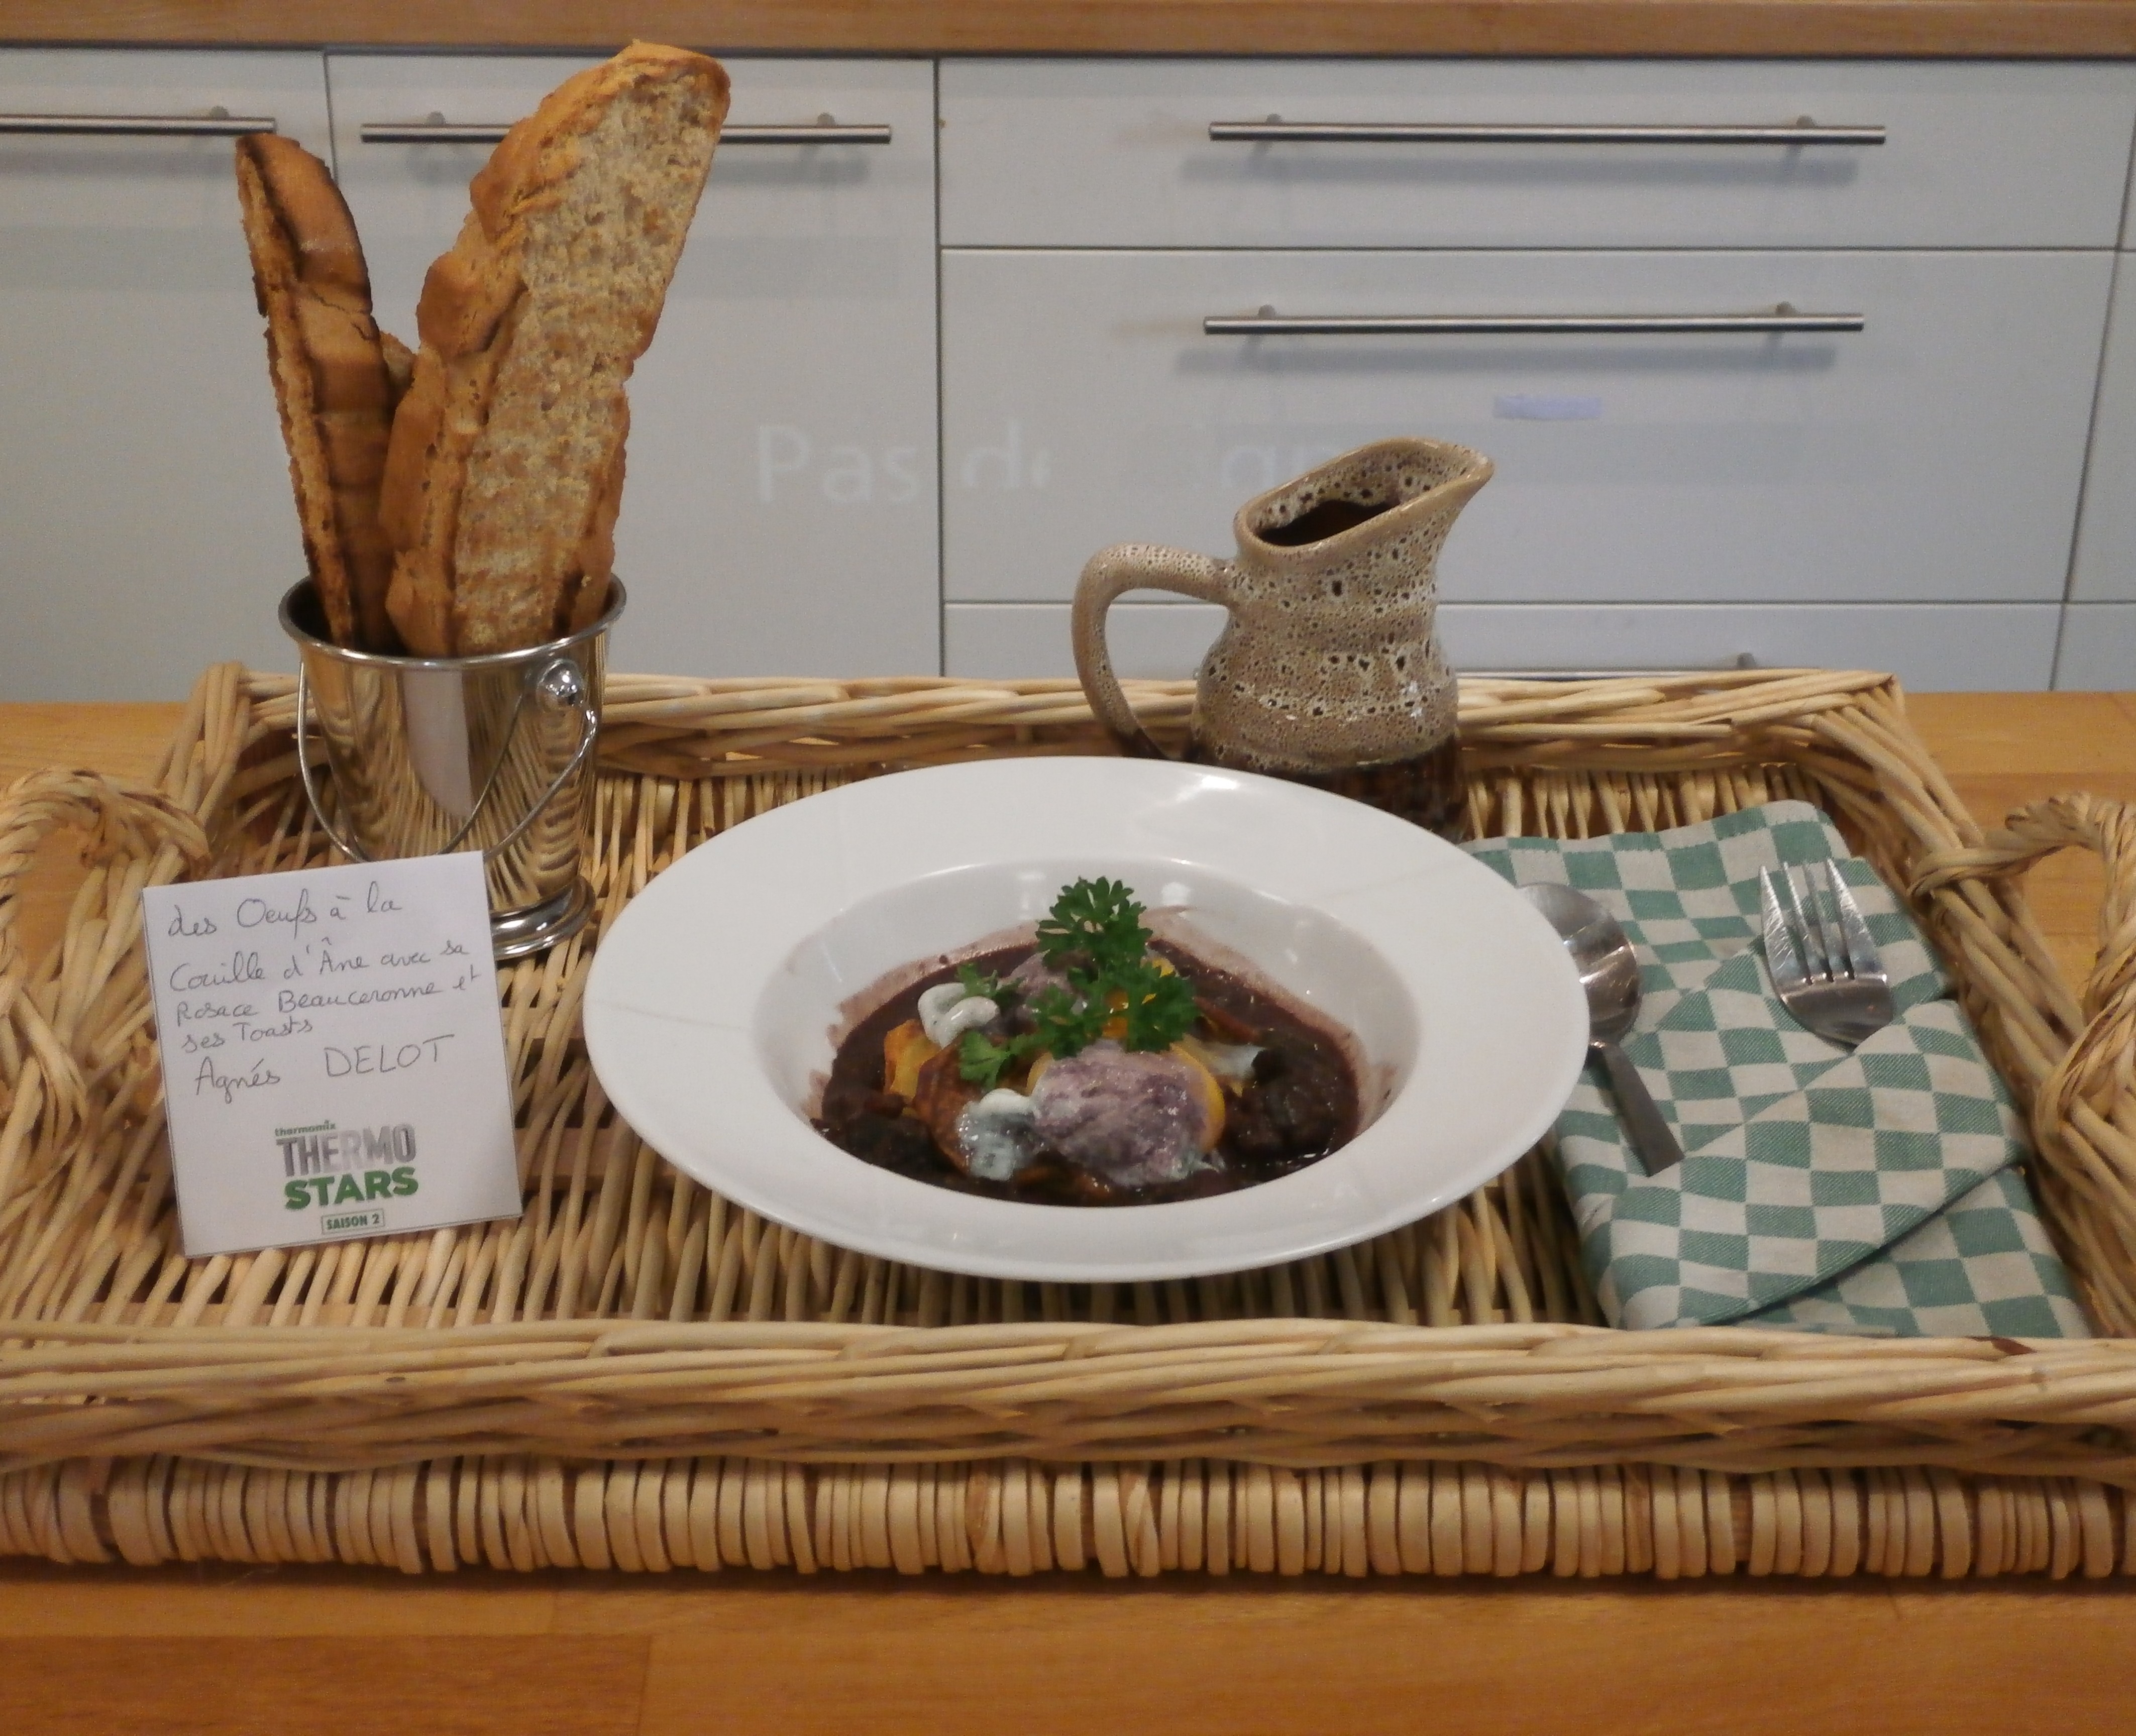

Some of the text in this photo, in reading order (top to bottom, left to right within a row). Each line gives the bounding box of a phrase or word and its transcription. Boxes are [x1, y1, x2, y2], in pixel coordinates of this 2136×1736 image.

[758, 424, 919, 502] Pas
[168, 905, 217, 936] des
[367, 881, 402, 913] la
[170, 951, 264, 992] Couille
[381, 952, 431, 967] avec
[176, 964, 482, 1027] Rosace Beauceronne et
[181, 1016, 313, 1053] ses Toasts
[324, 1033, 456, 1078] DELOT
[274, 1119, 336, 1136] thermomix
[276, 1123, 416, 1177] THERMO
[284, 1166, 418, 1210] STARS
[327, 1214, 380, 1230] SAISON 2
